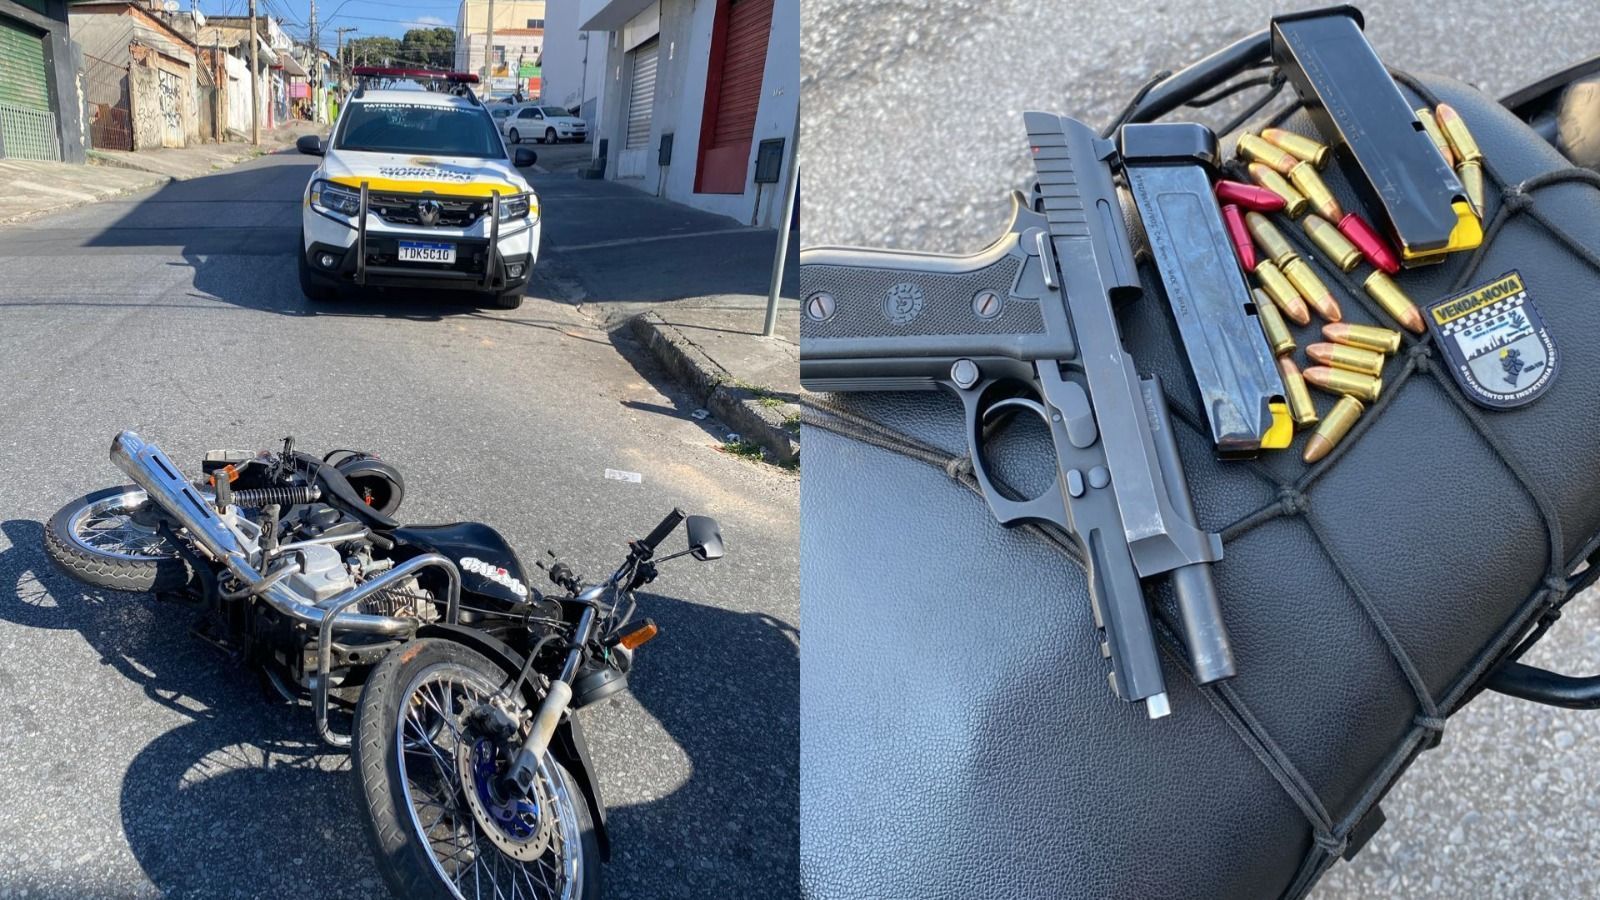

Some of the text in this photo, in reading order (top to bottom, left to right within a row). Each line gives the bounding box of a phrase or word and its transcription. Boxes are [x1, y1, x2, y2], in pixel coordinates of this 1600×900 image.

[404, 247, 449, 260] TDK5C10
[1436, 279, 1519, 320] VENDA-NOVA
[1461, 365, 1503, 400] GRUPAMENTO
[1516, 368, 1553, 399] INSPETORIA
[1539, 328, 1555, 367] REGIONAL
